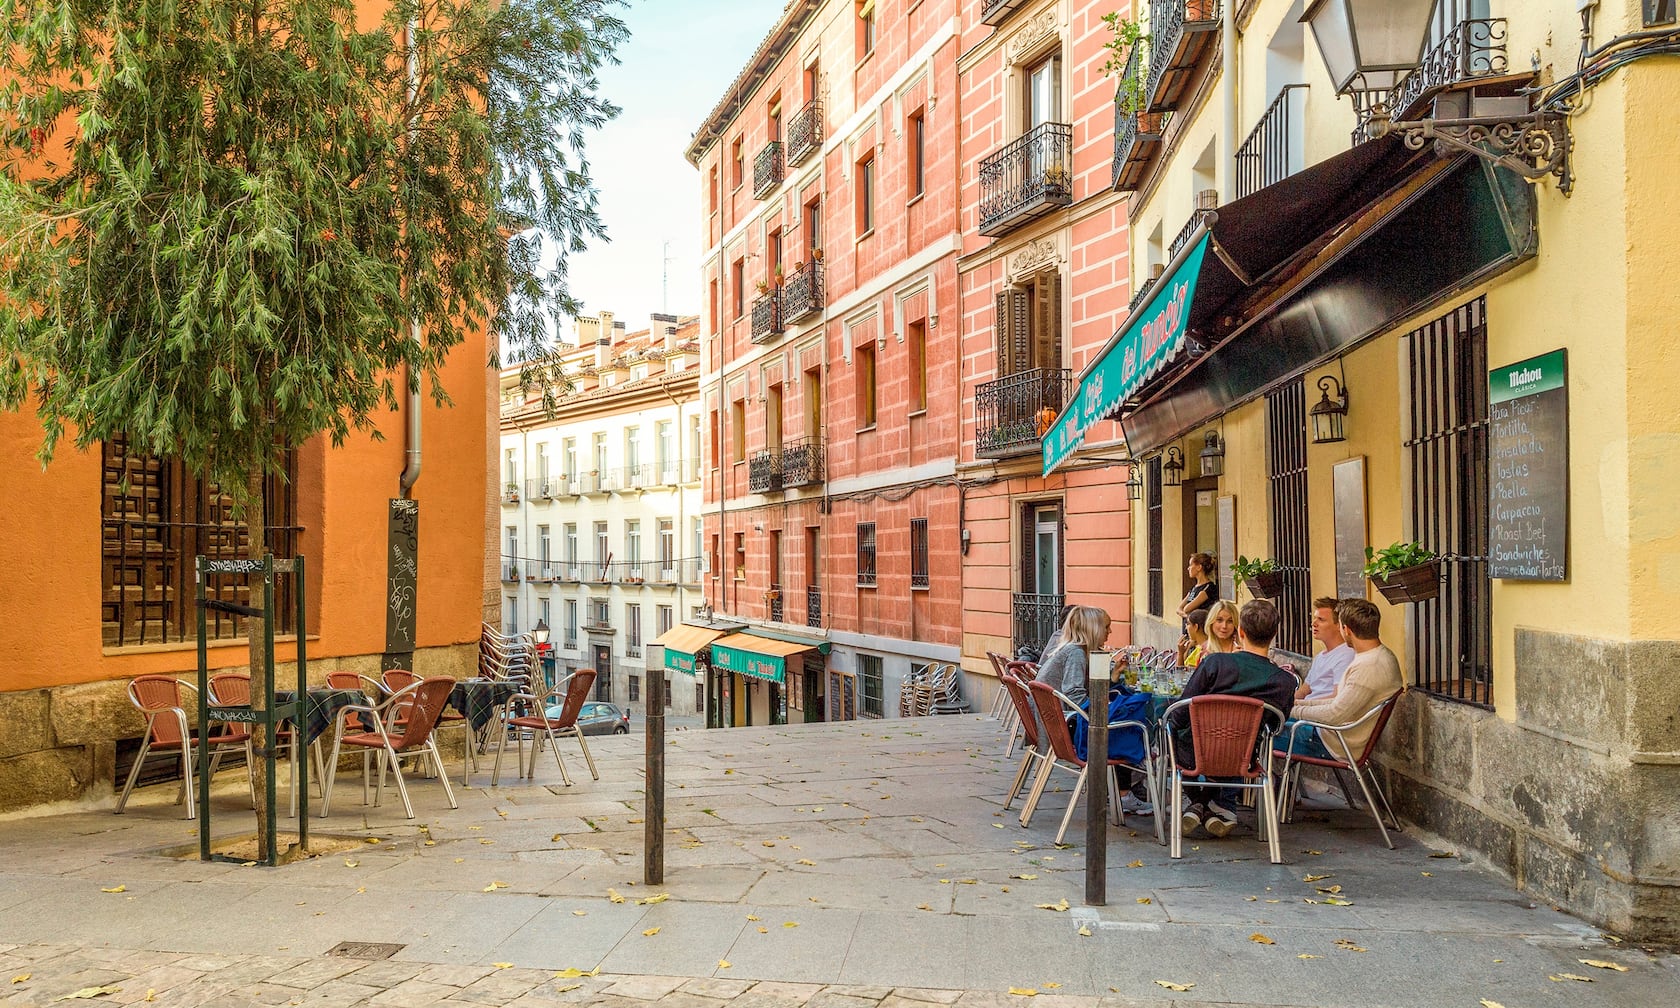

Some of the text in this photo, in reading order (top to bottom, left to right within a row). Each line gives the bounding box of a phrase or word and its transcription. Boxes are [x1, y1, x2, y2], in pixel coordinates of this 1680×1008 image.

[1084, 369, 1104, 418] Café
[1122, 336, 1138, 386] del
[1509, 368, 1542, 388] Mahou
[1495, 418, 1529, 438] Tortilla
[1497, 460, 1529, 479] Tostas
[1496, 500, 1541, 525] Carpaccio
[1496, 517, 1547, 546] Roast Beef
